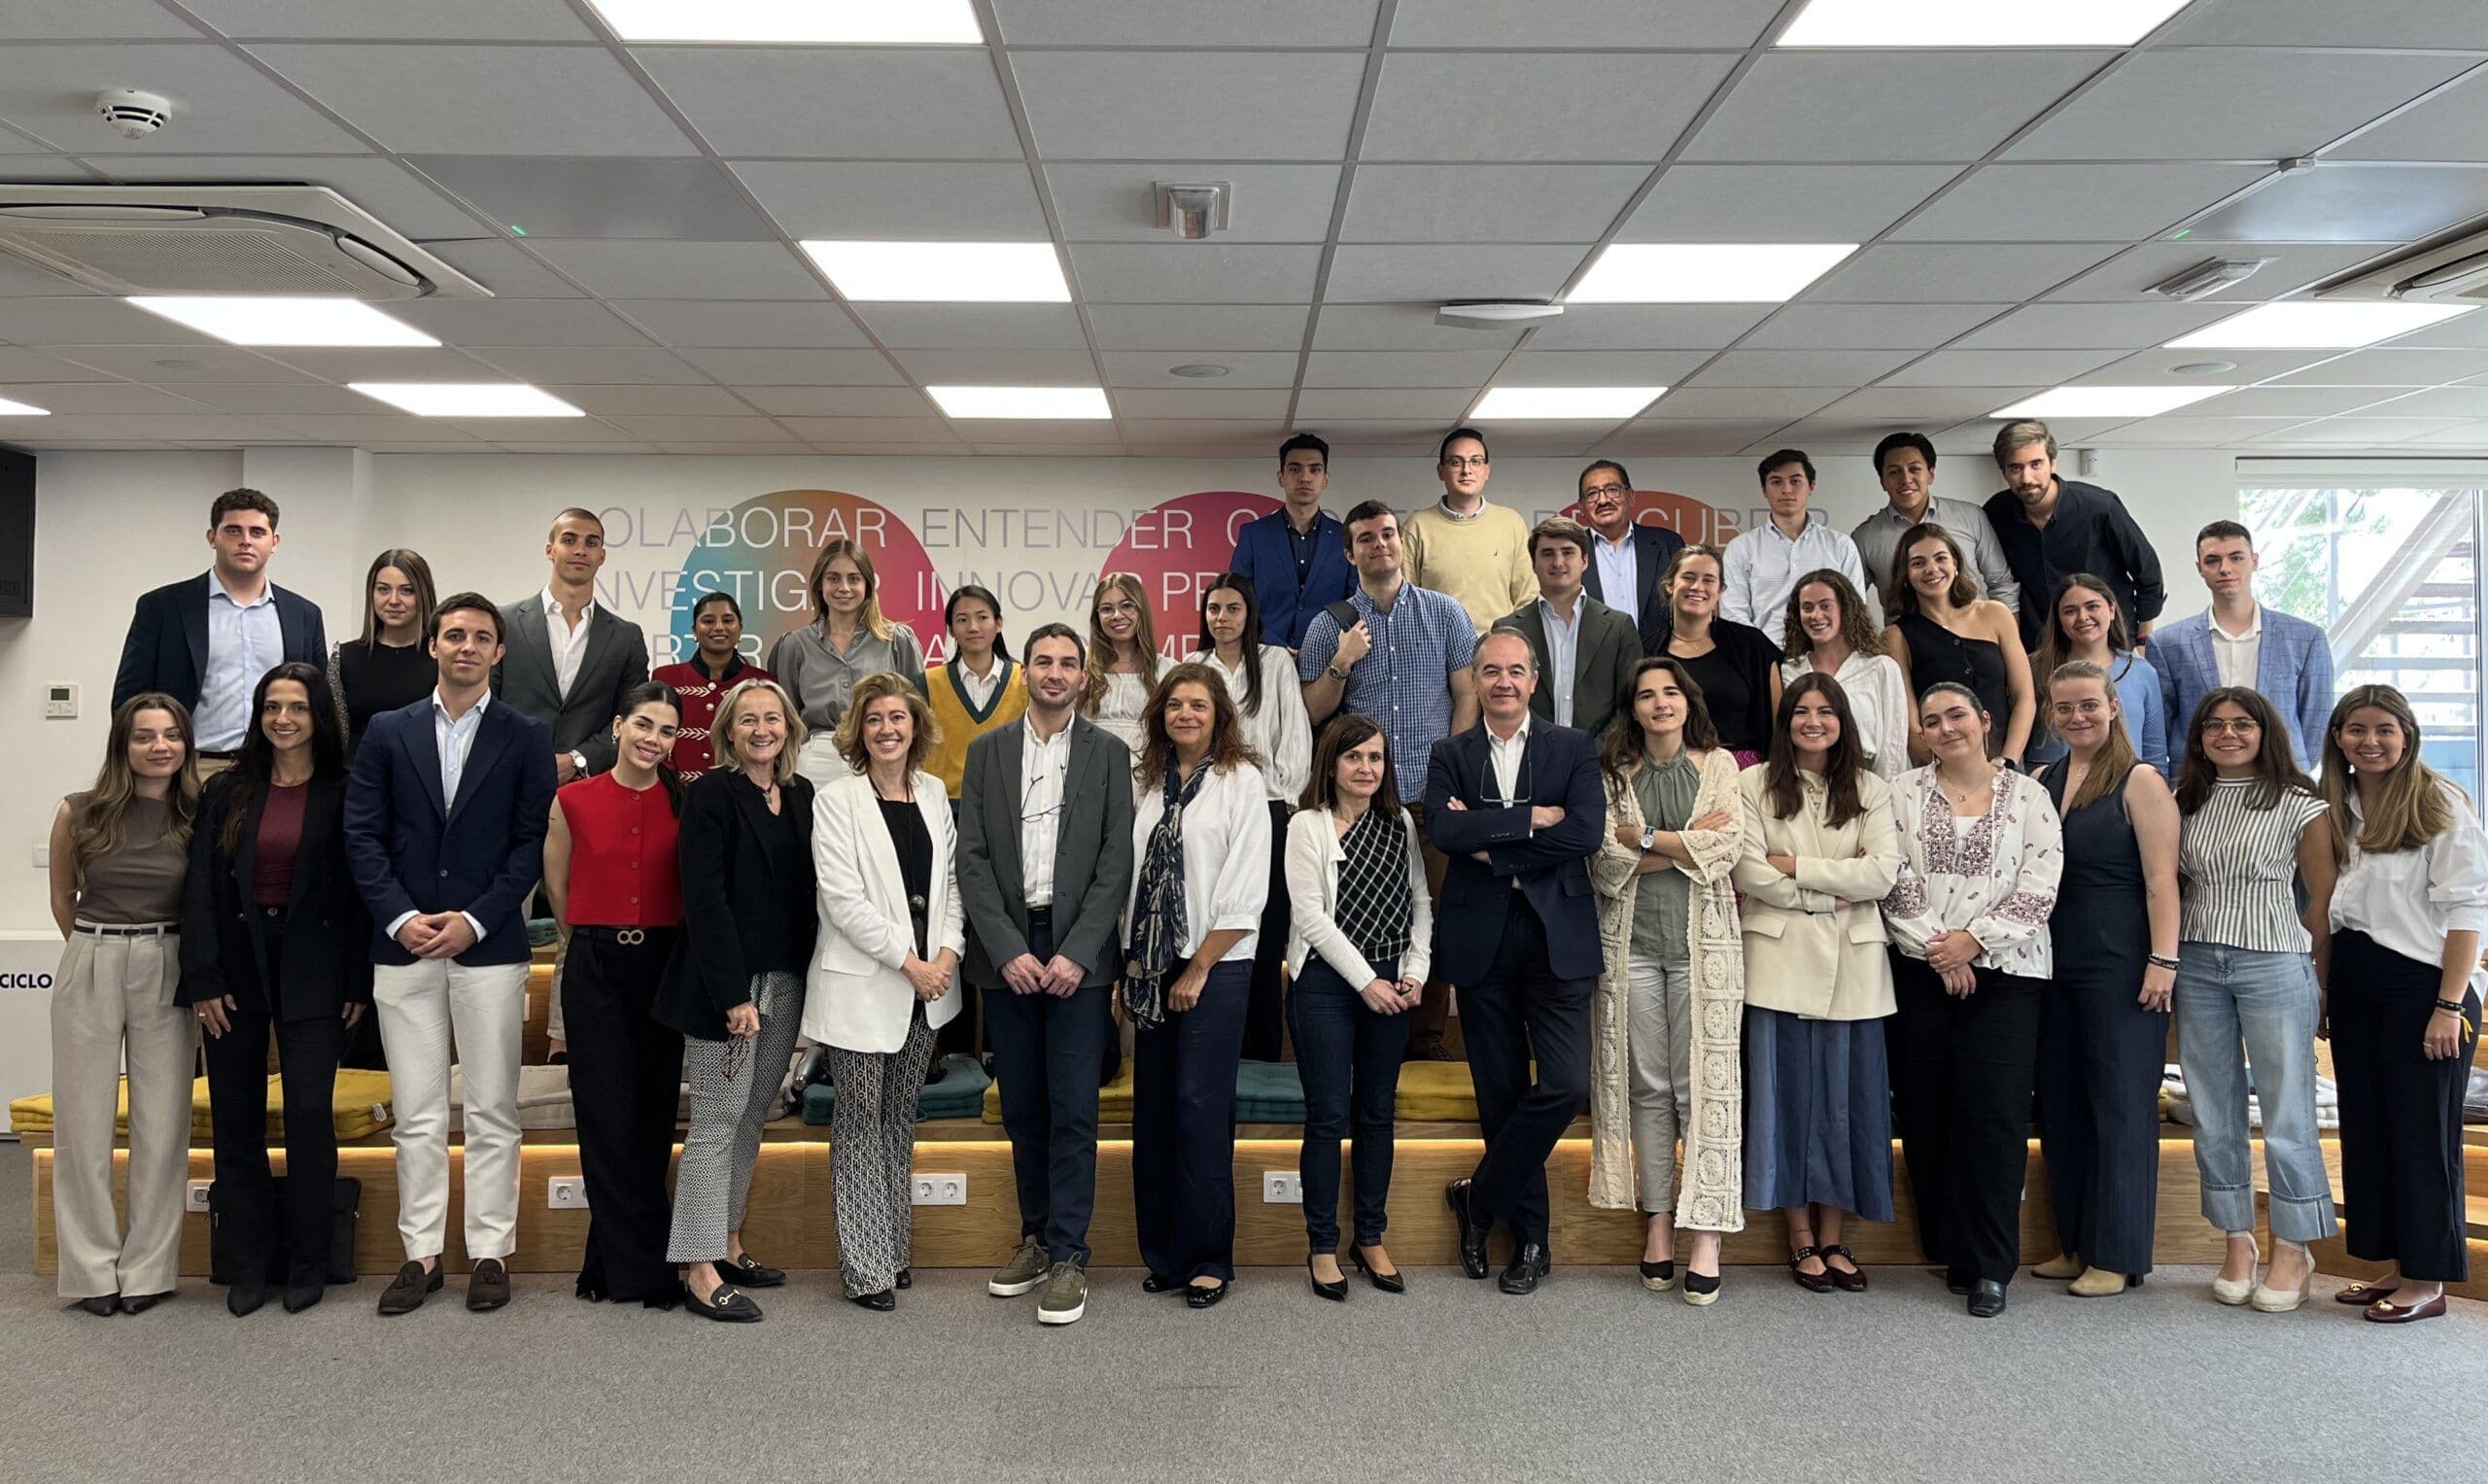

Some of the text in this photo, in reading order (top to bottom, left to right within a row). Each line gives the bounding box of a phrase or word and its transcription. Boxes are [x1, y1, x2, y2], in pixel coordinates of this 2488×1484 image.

[599, 506, 886, 548] OLABORAR
[922, 507, 1193, 549] ENTENDER
[916, 570, 1142, 612] INNOVA
